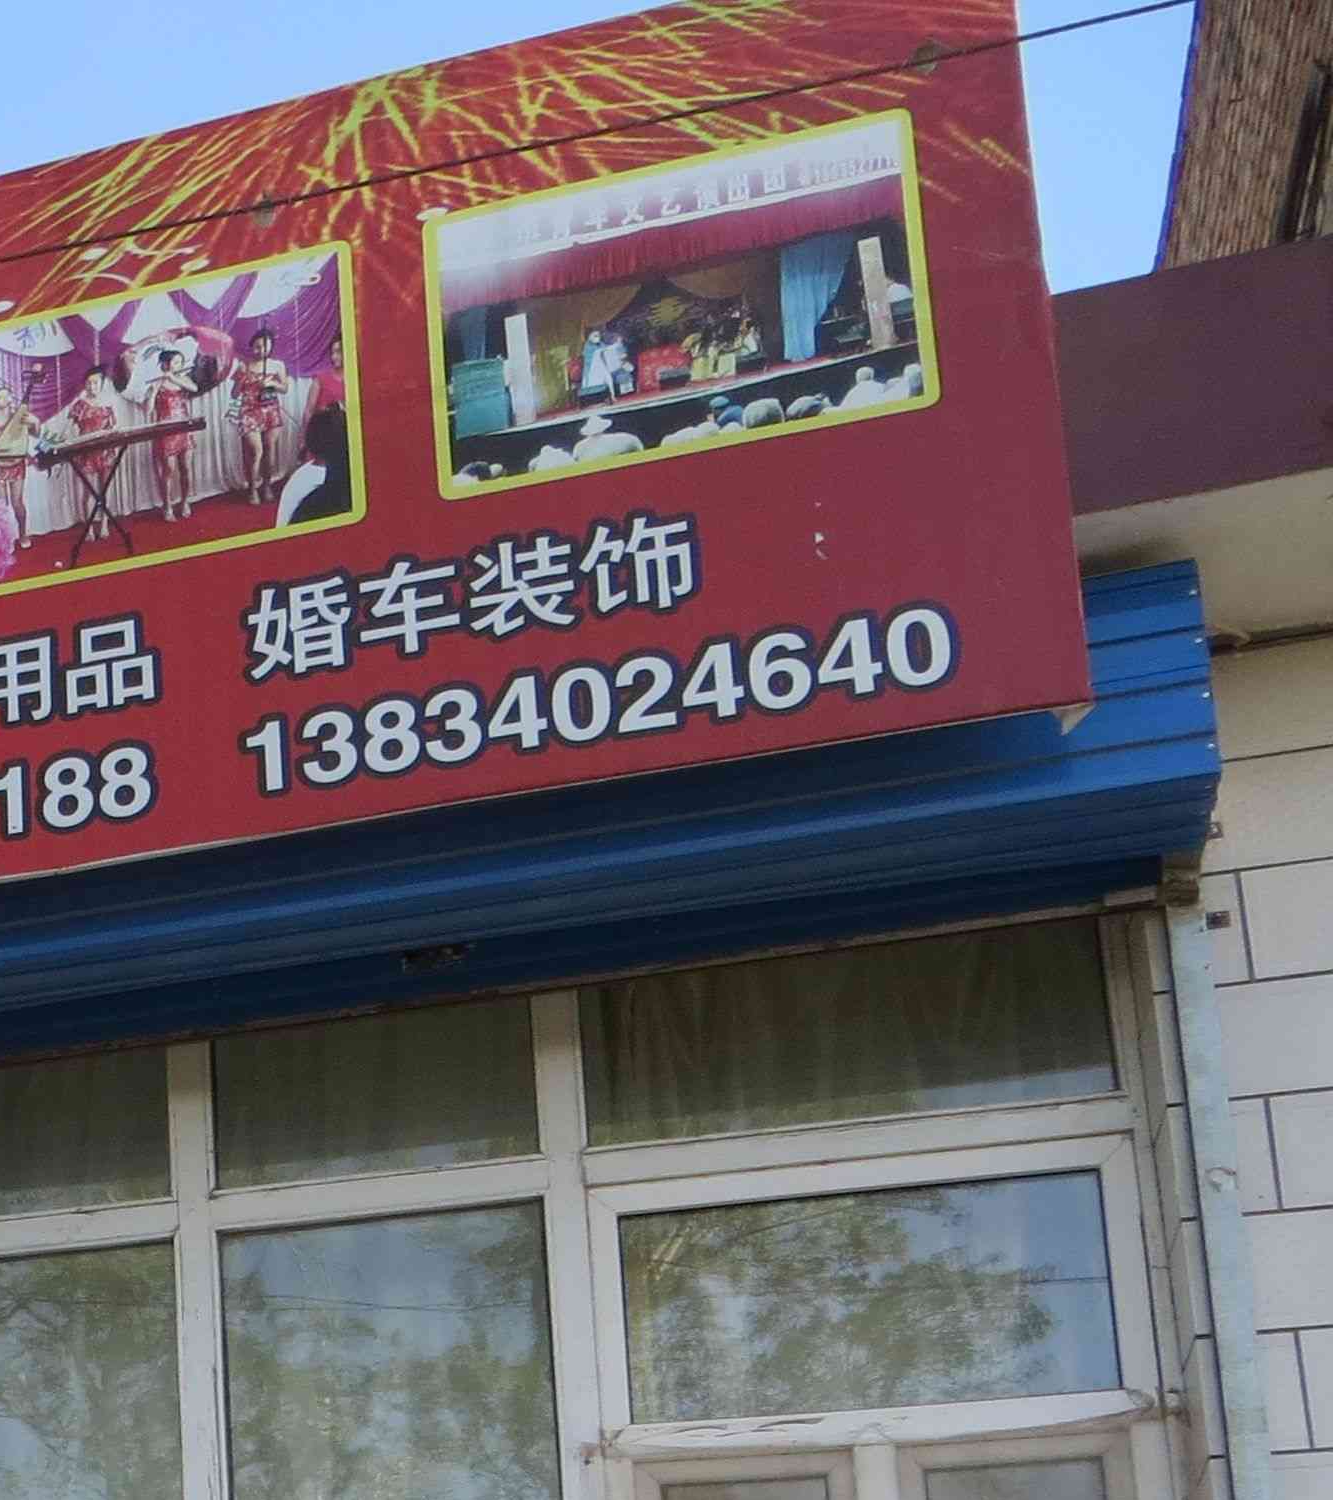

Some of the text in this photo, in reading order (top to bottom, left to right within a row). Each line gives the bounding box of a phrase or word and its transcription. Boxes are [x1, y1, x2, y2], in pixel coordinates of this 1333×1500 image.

[248, 518, 692, 679] 婚车装饰
[247, 609, 950, 790] 13834024640
